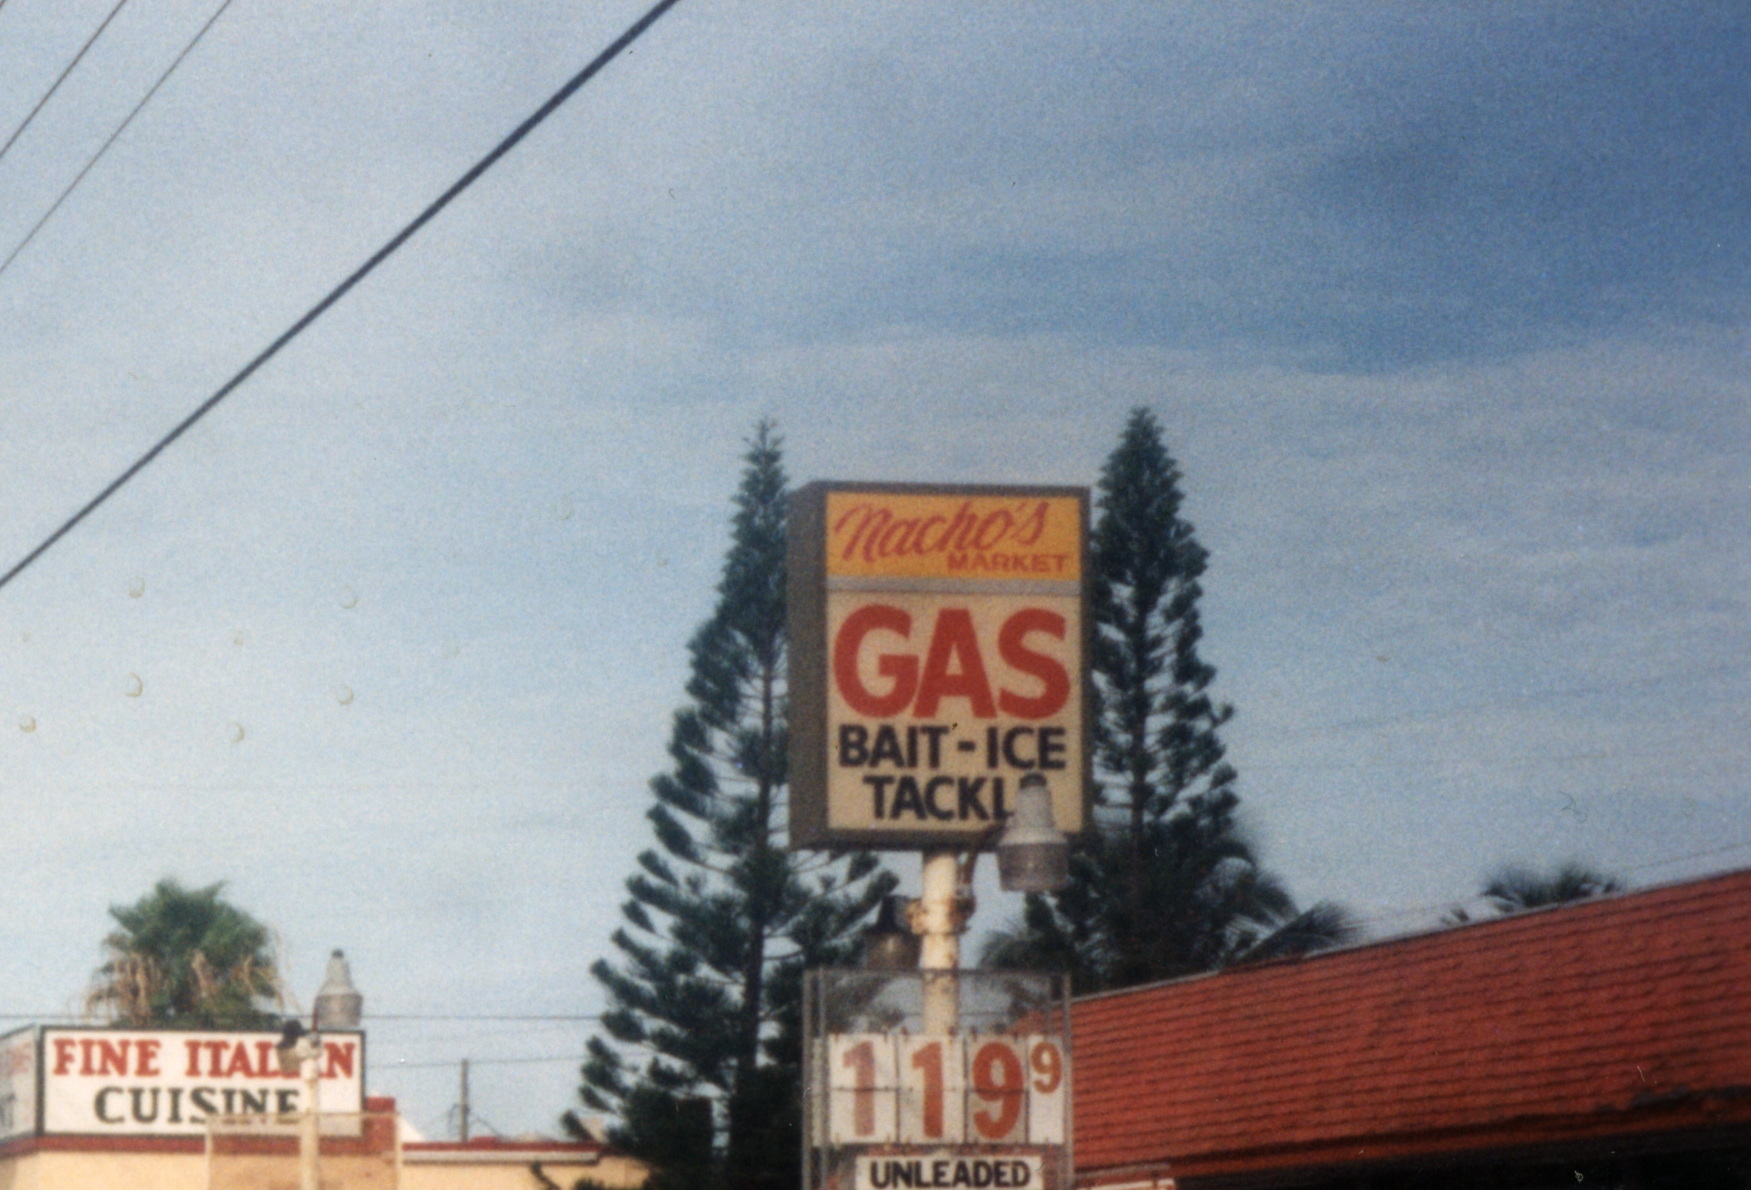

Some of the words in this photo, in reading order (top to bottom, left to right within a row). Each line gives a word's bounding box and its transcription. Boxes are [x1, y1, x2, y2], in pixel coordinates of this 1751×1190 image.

[948, 554, 1068, 573] MARKET
[833, 604, 1071, 720] GAS
[837, 725, 949, 769] BAIT
[986, 727, 1067, 770] ICE
[863, 775, 1014, 820] TACKL
[53, 1038, 161, 1077] FINE
[94, 1086, 301, 1124] CUISINE
[870, 1160, 1031, 1188] UNLEADED
